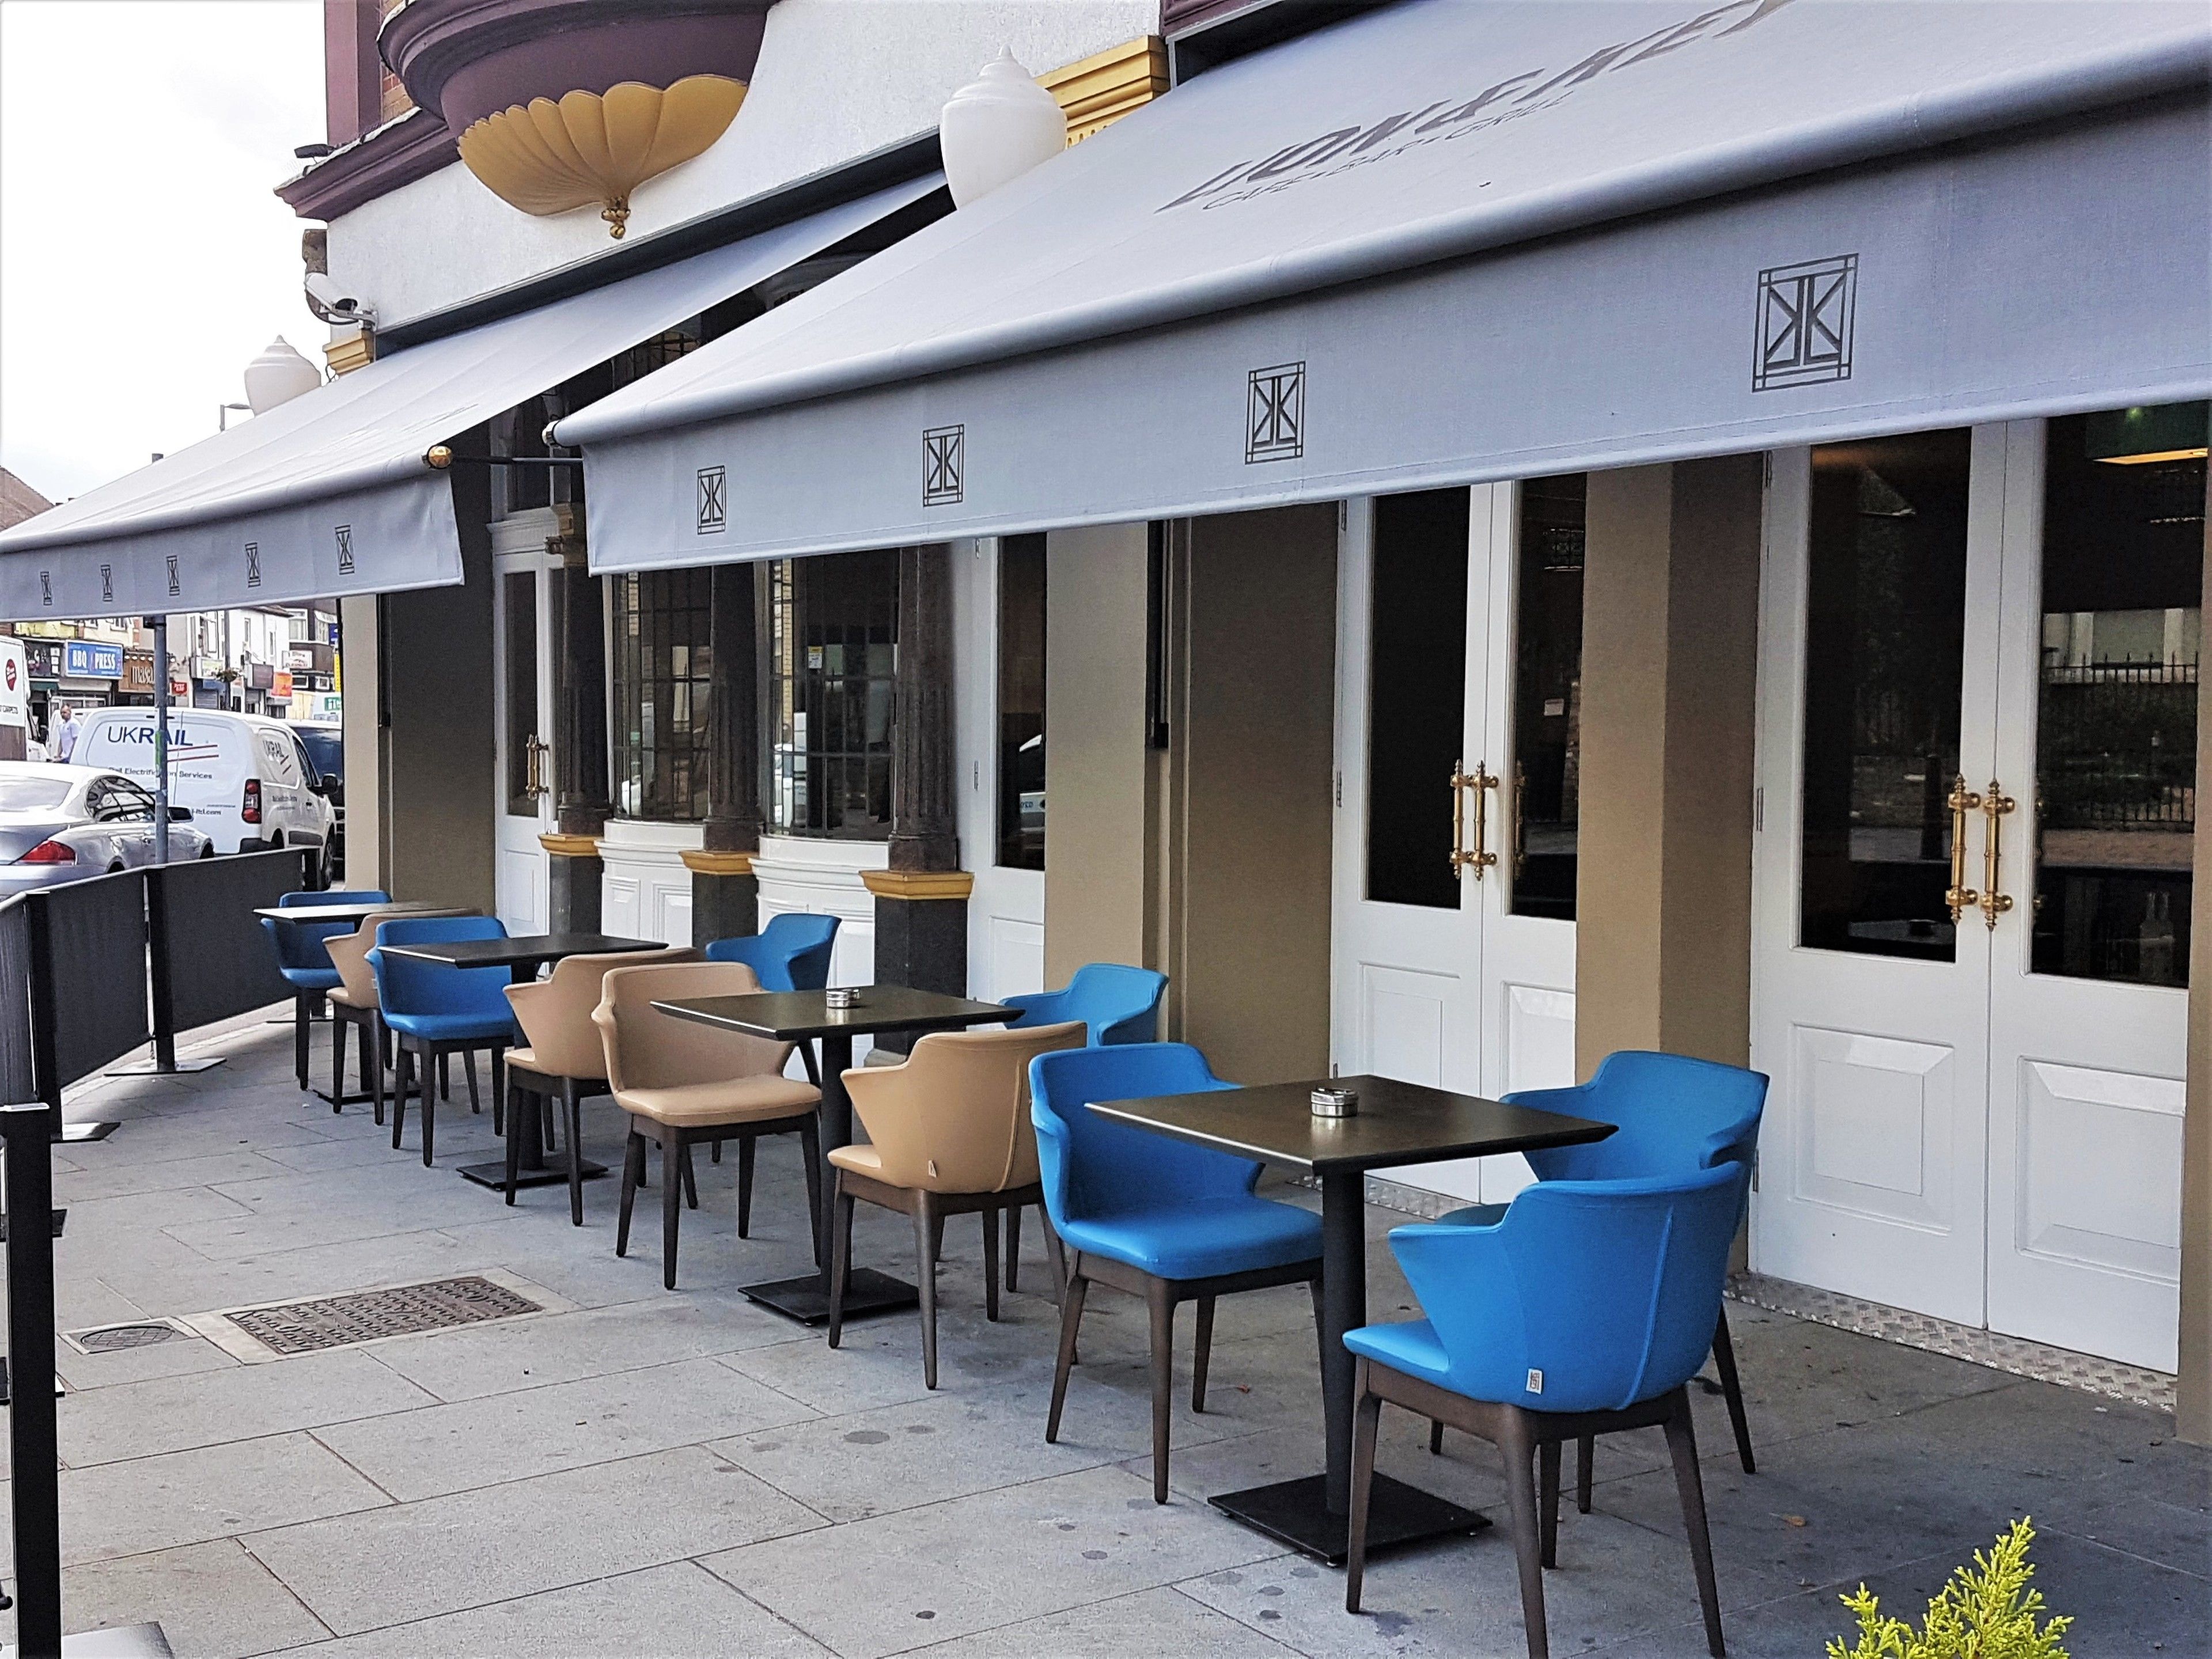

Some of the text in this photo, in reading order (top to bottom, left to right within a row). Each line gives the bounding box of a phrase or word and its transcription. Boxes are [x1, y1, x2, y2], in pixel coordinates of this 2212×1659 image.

[1154, 99, 1453, 214] LION
[1414, 67, 1546, 135] &
[1202, 90, 1575, 210] CAFE BAR GRILL
[73, 650, 87, 668] BBQ
